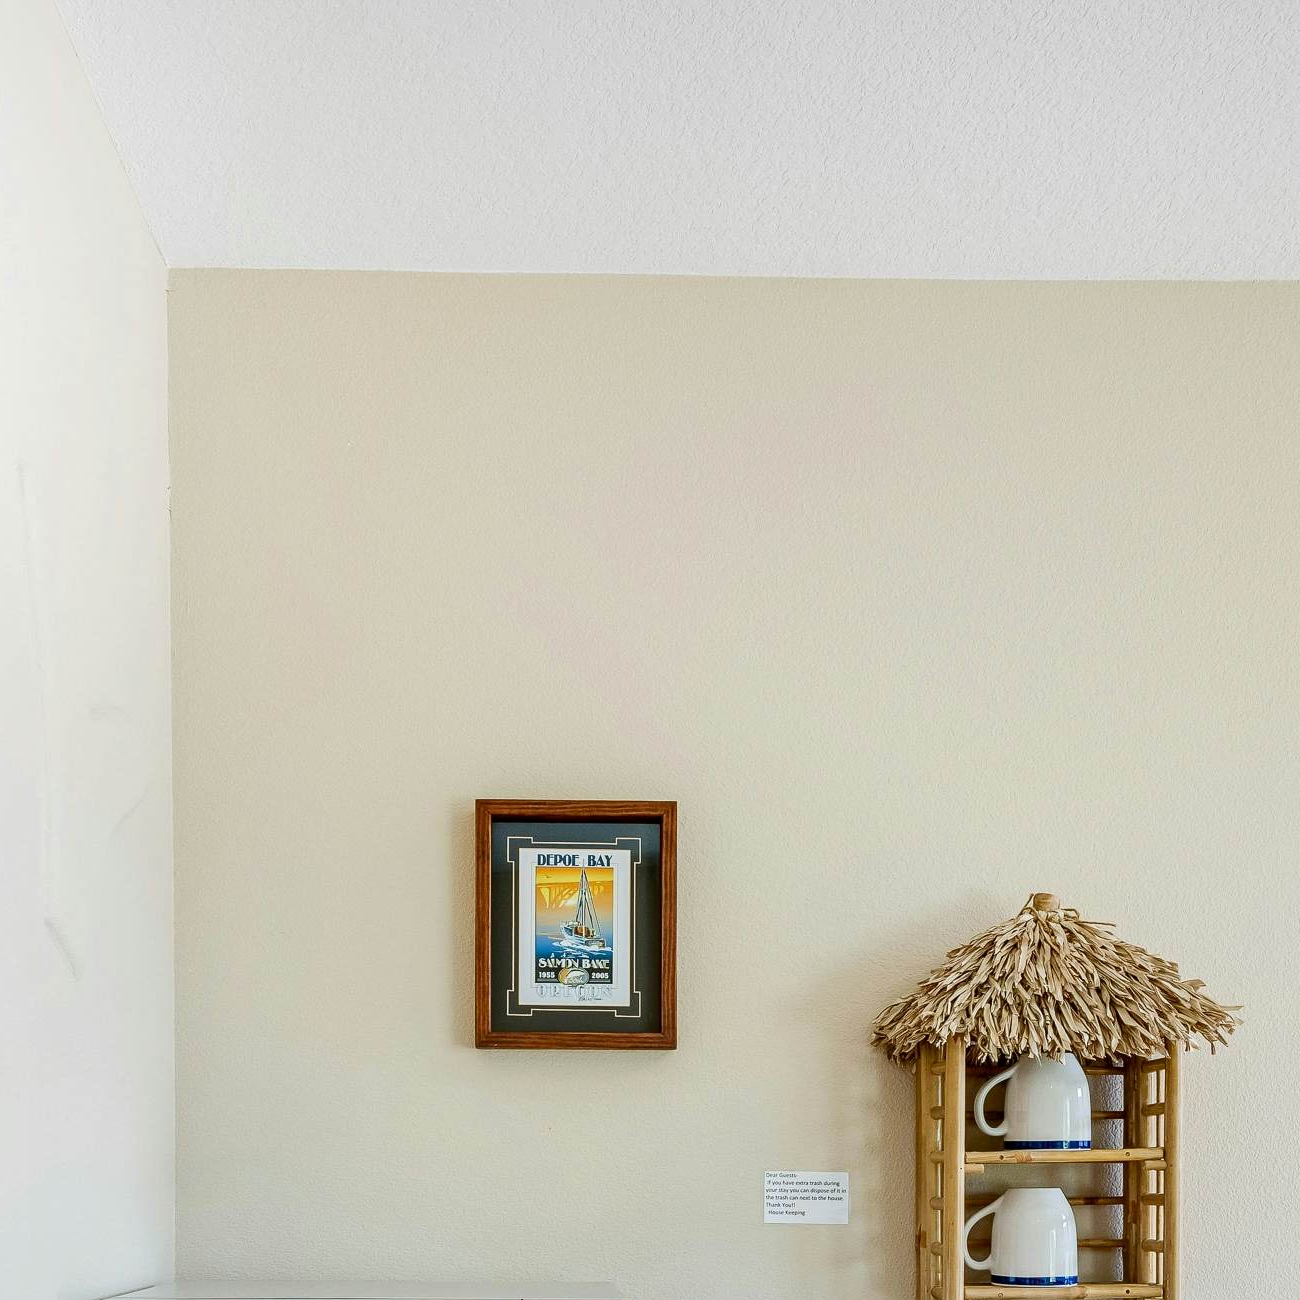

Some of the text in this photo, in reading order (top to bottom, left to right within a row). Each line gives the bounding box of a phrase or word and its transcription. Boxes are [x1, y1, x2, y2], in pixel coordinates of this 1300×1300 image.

[537, 853, 613, 867] DEPOE BAY
[581, 958, 610, 969] BAKE
[539, 971, 556, 979] 1955
